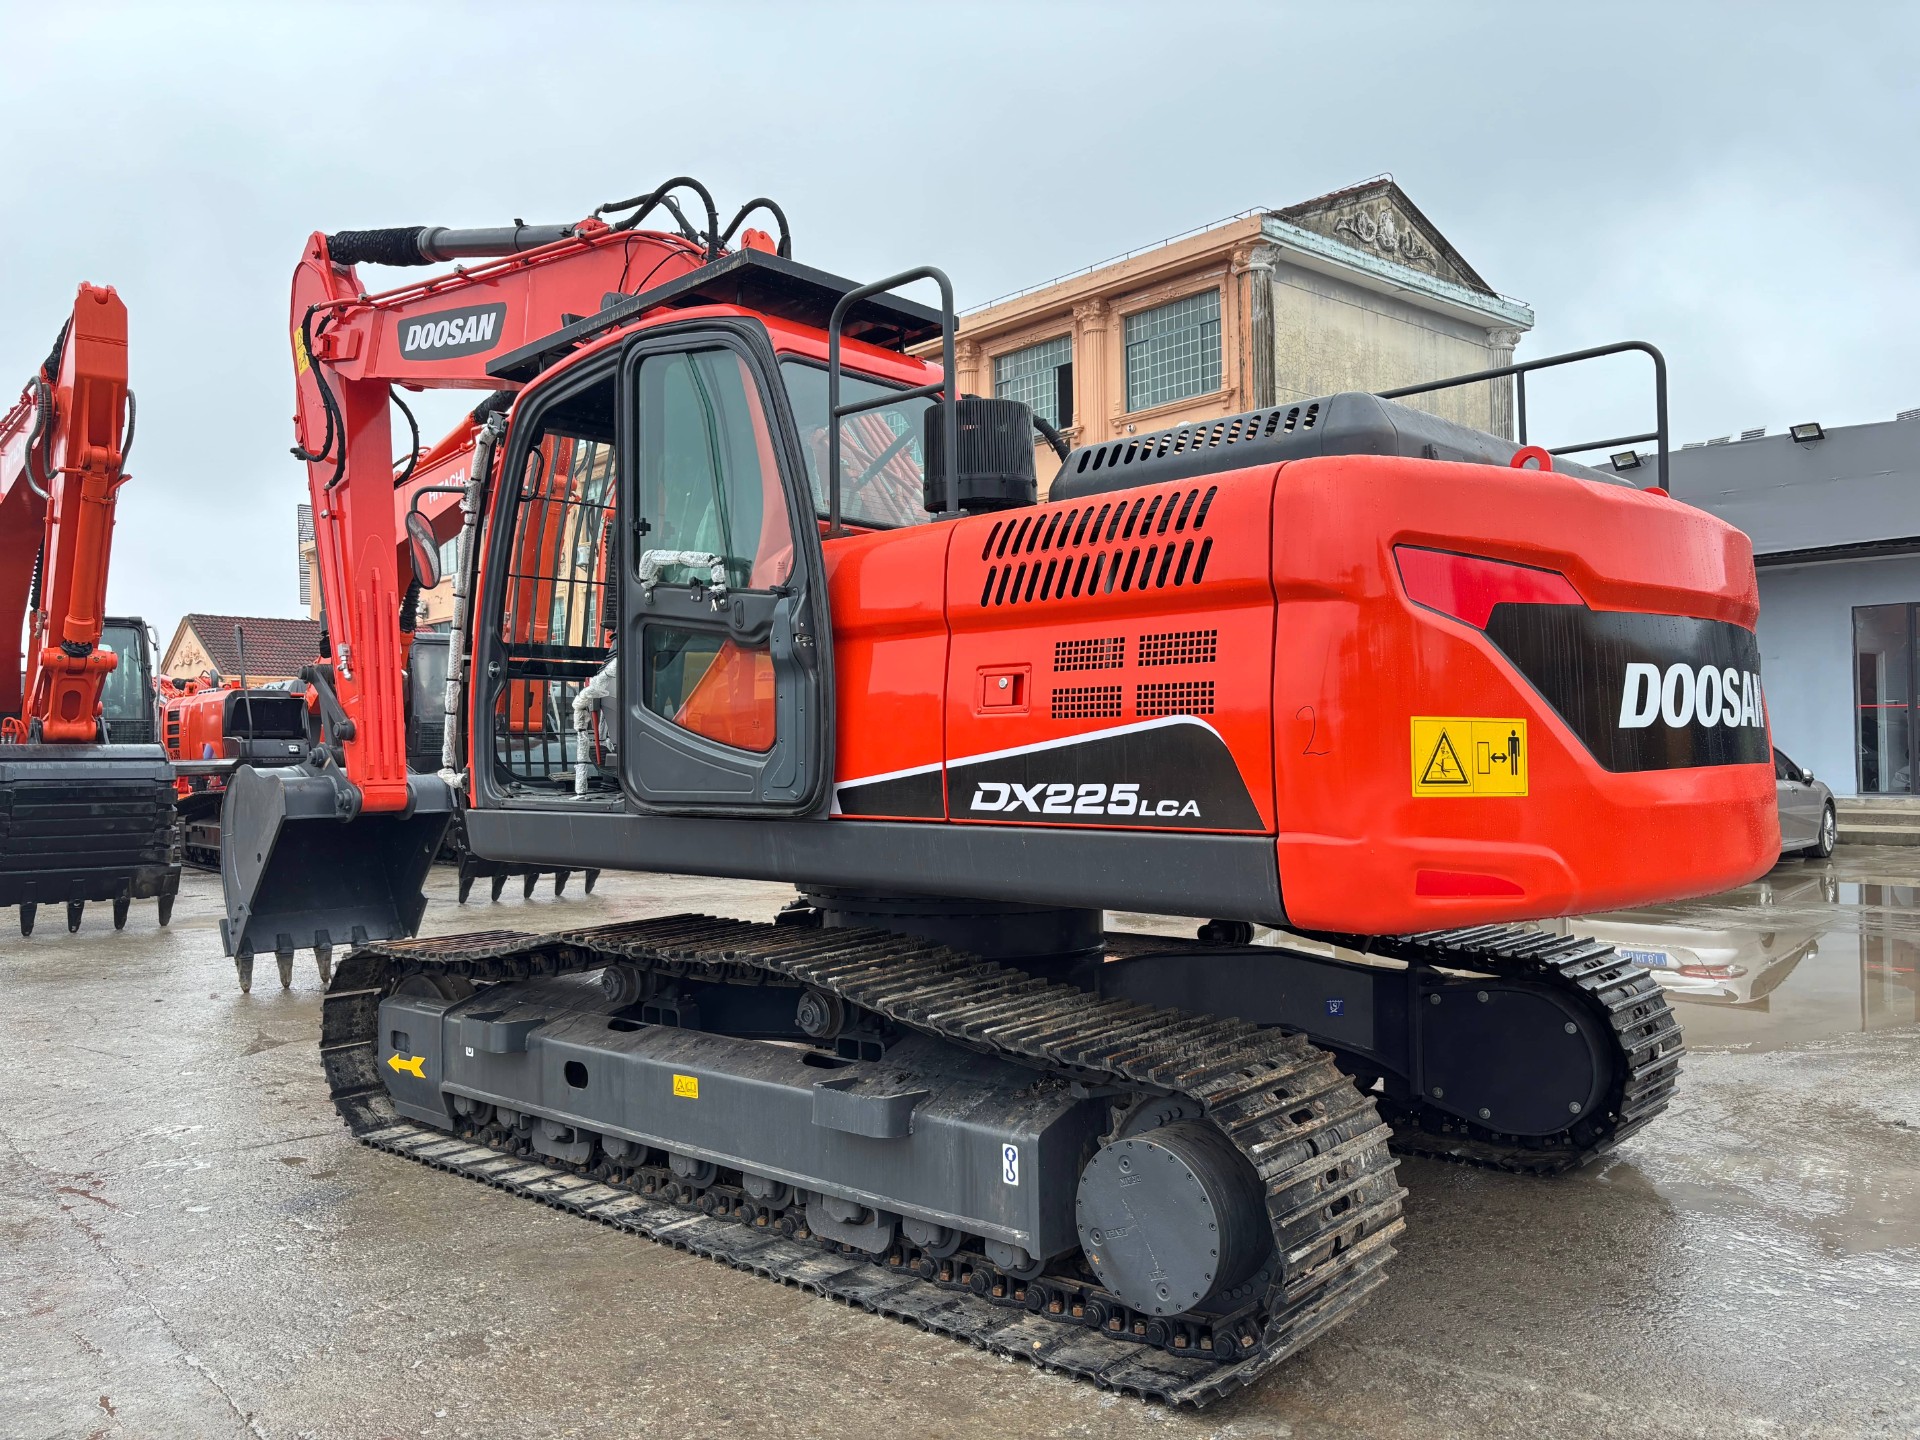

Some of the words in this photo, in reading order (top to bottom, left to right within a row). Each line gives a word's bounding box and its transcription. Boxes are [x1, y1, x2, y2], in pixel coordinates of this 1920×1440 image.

[405, 312, 497, 352] DOOSAN
[1618, 662, 1765, 729] DOOSAN
[1296, 705, 1331, 756] 2
